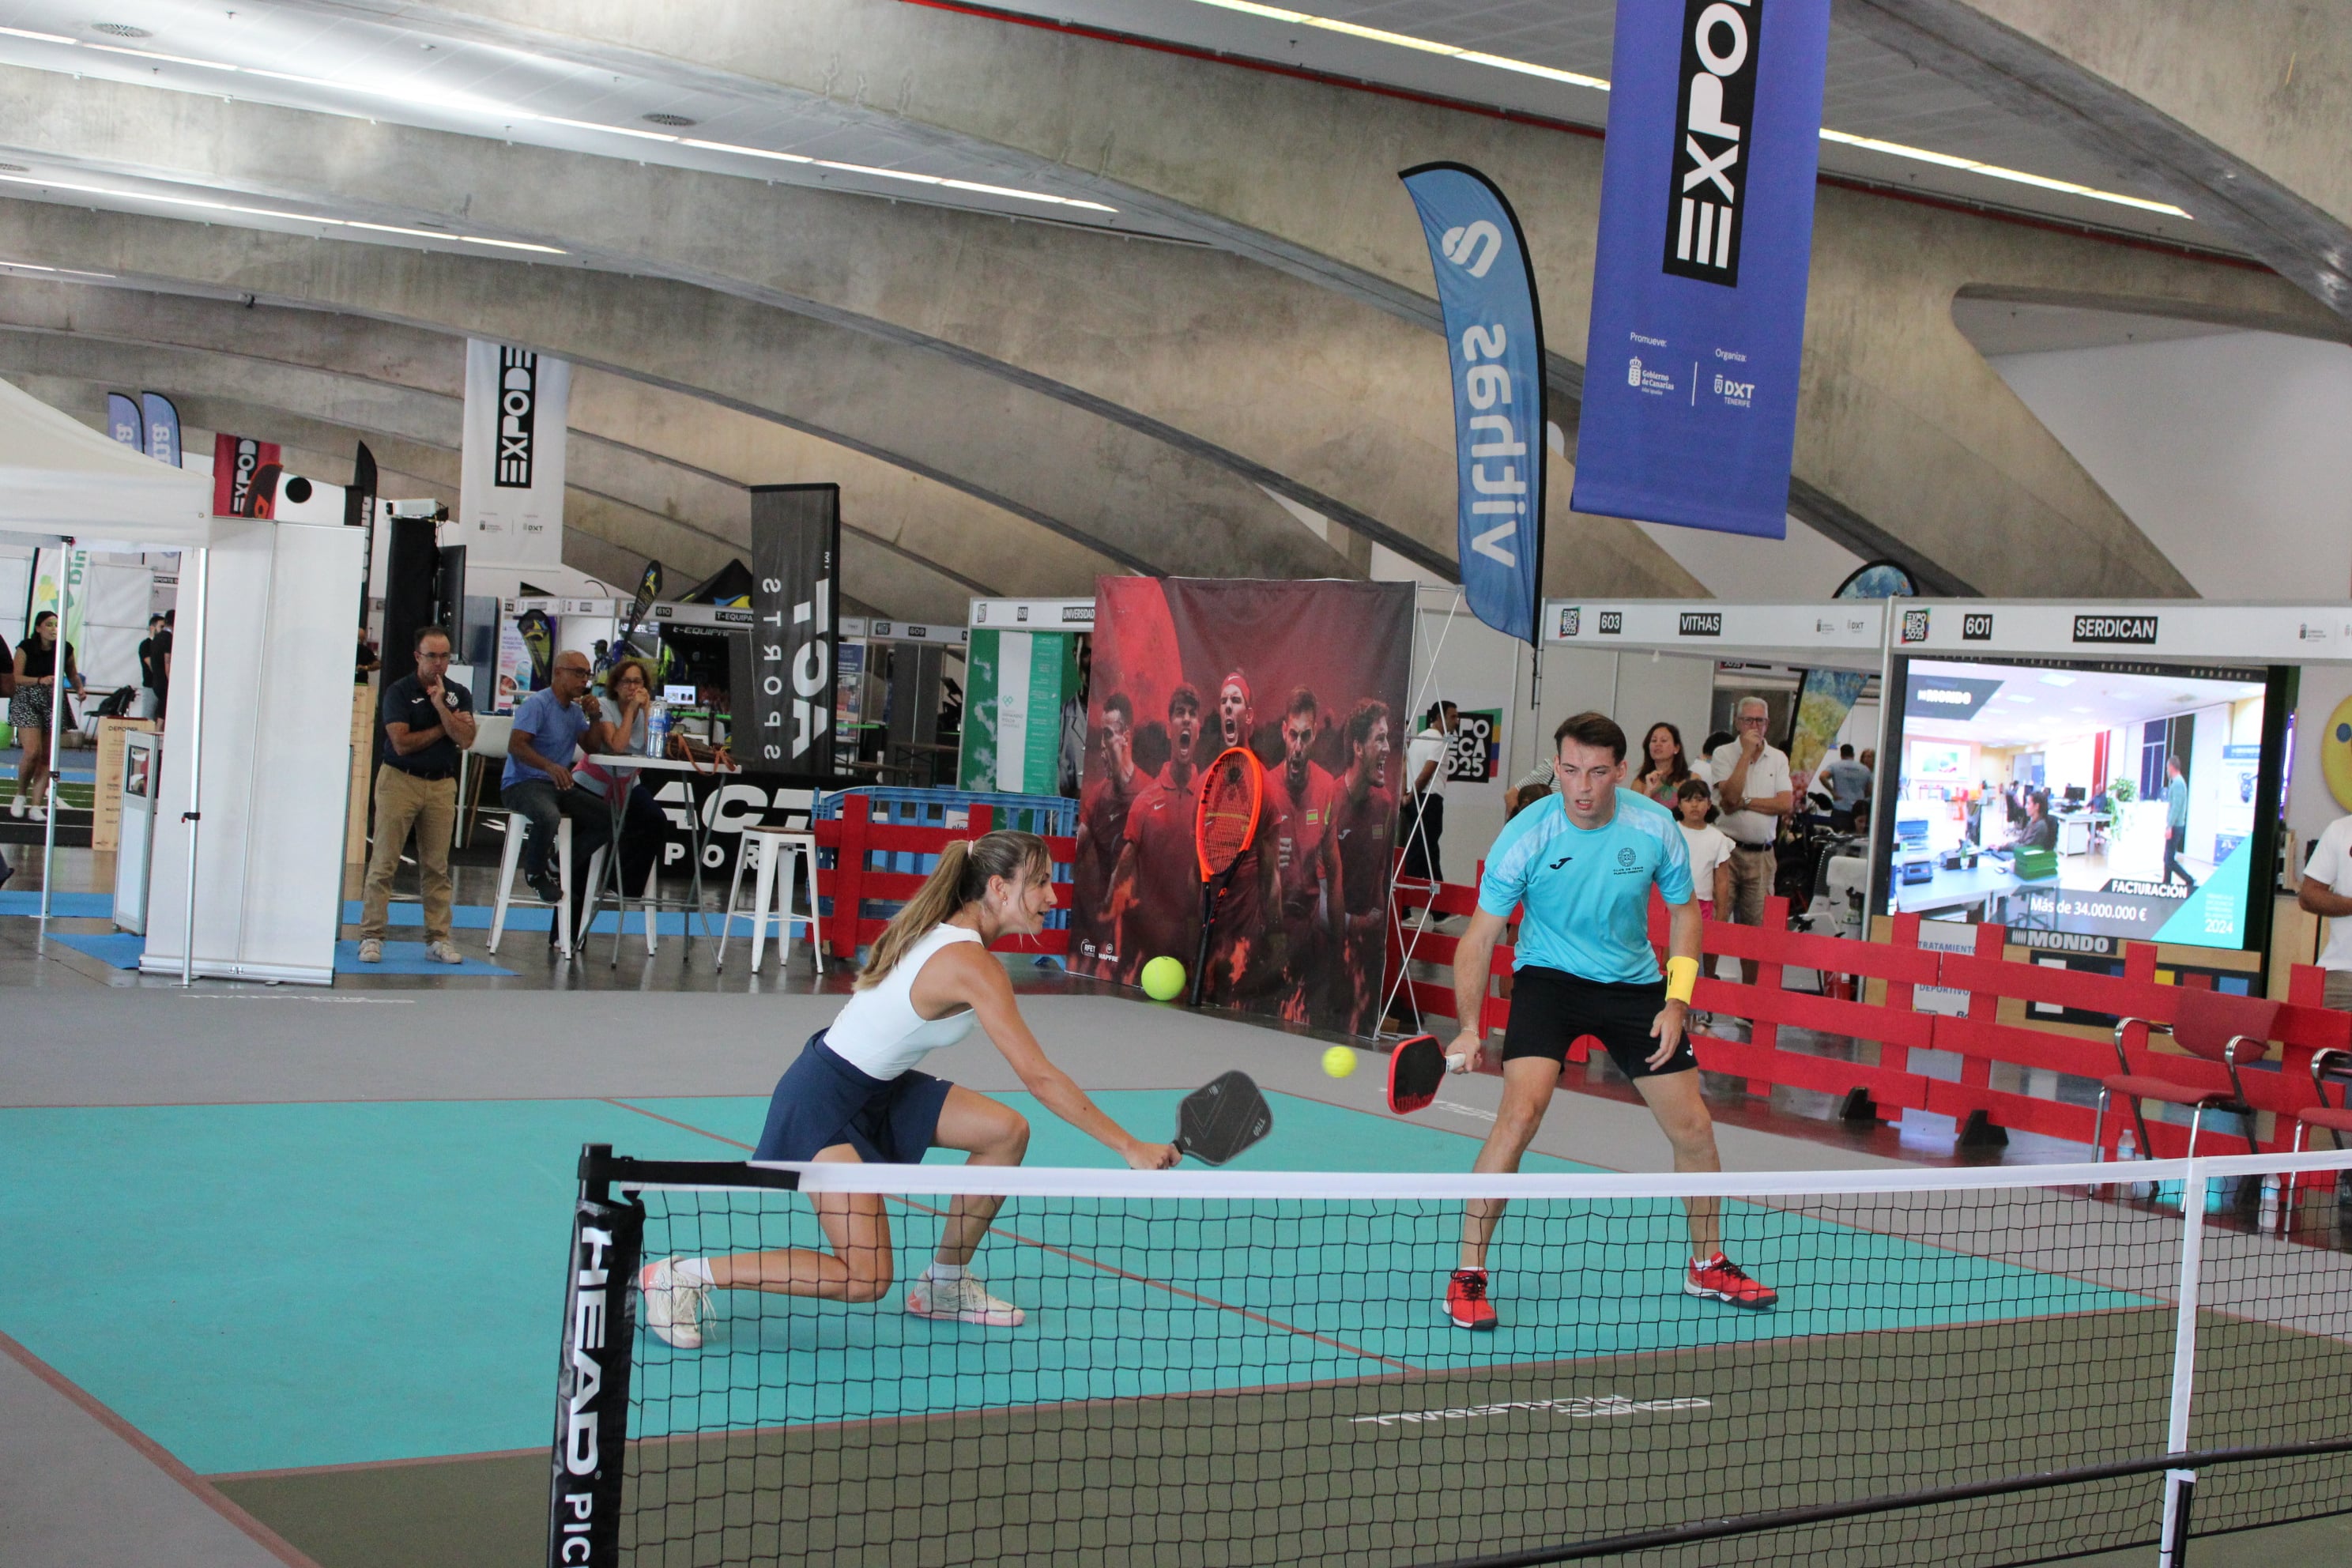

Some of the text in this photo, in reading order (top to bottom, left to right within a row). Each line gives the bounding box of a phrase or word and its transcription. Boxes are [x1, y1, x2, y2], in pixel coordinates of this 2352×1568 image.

[1677, 0, 1752, 269] EXPO
[1630, 332, 1667, 347] Promueve:
[1715, 348, 1747, 362] Organiza:
[1642, 370, 1669, 381] Gobierno
[1649, 379, 1675, 390] Canarias
[1724, 381, 1755, 399] DXT
[1724, 397, 1751, 408] TENERIFE
[1063, 609, 1095, 620] UNIVERSIDAD
[1601, 615, 1720, 631] 603 VITHAS
[1852, 621, 1864, 630] DXT
[1966, 617, 2155, 639] 601 SERDICAN
[1449, 737, 1487, 758] ECA
[1449, 756, 1484, 777] 025
[2112, 880, 2188, 899] FACTURACIÓN
[2030, 897, 2147, 922] Más de 34.000.000 €
[2204, 918, 2234, 934] 2024
[2027, 930, 2109, 953] MONDO
[1098, 953, 1119, 963] MAPFRE
[566, 1227, 612, 1476] HEAD
[562, 1492, 593, 1568] PIC
